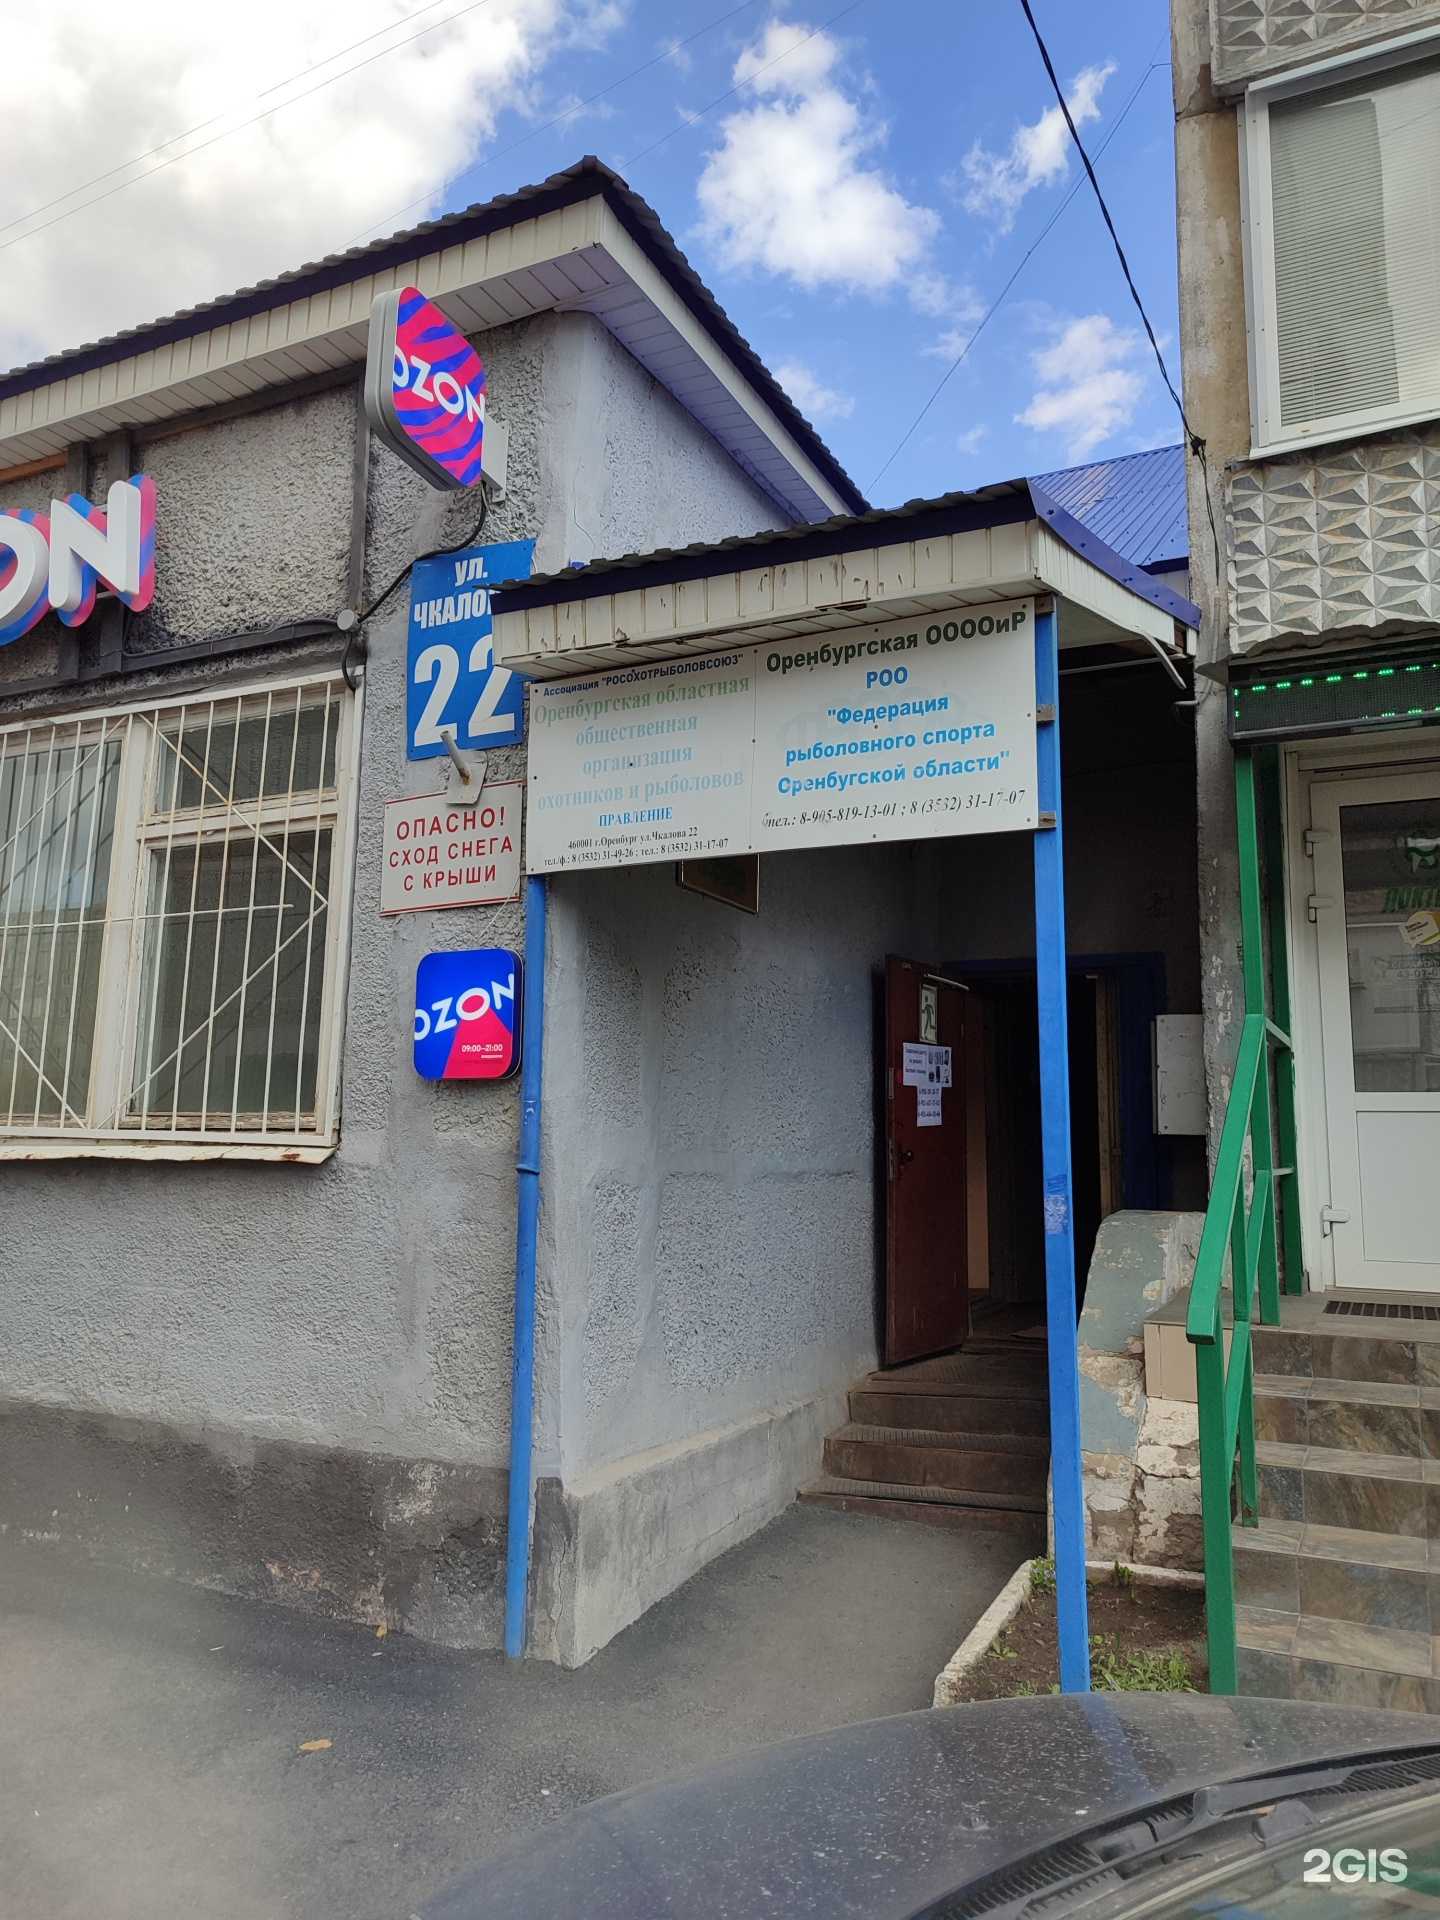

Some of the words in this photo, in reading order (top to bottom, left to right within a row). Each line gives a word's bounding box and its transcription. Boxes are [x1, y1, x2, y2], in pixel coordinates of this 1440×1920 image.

[393, 344, 485, 424] OZON
[455, 556, 488, 587] ул.
[766, 632, 918, 674] Оренбургская
[925, 611, 1026, 646] ООООиР
[413, 633, 515, 747] 22
[543, 680, 599, 697] Ассоциация
[602, 653, 744, 685] "РОСОХОТРЫБОЛОВСОЮЗ"
[866, 667, 908, 688] РОО
[534, 691, 650, 728] Оренбургская
[656, 676, 751, 705] областная
[827, 695, 949, 725] "Федерация
[576, 715, 698, 746] общественная
[785, 733, 916, 766] рыболовного
[923, 722, 995, 745] спорта
[583, 746, 693, 778] организация
[913, 750, 1010, 779] области"
[537, 785, 624, 811] охотников
[629, 784, 639, 797] и
[645, 771, 745, 803] рыболовов
[396, 806, 505, 841] ОПАСНО!
[600, 806, 673, 827] ПРАВЛЕНИЕ
[799, 802, 897, 825] 8-905-819-13-01
[910, 801, 918, 815] 8
[388, 843, 438, 868] СХОД
[447, 835, 513, 859] СНЕГА
[403, 875, 413, 892] С
[423, 864, 496, 890] КРЫШИ
[414, 973, 514, 1041] OZON
